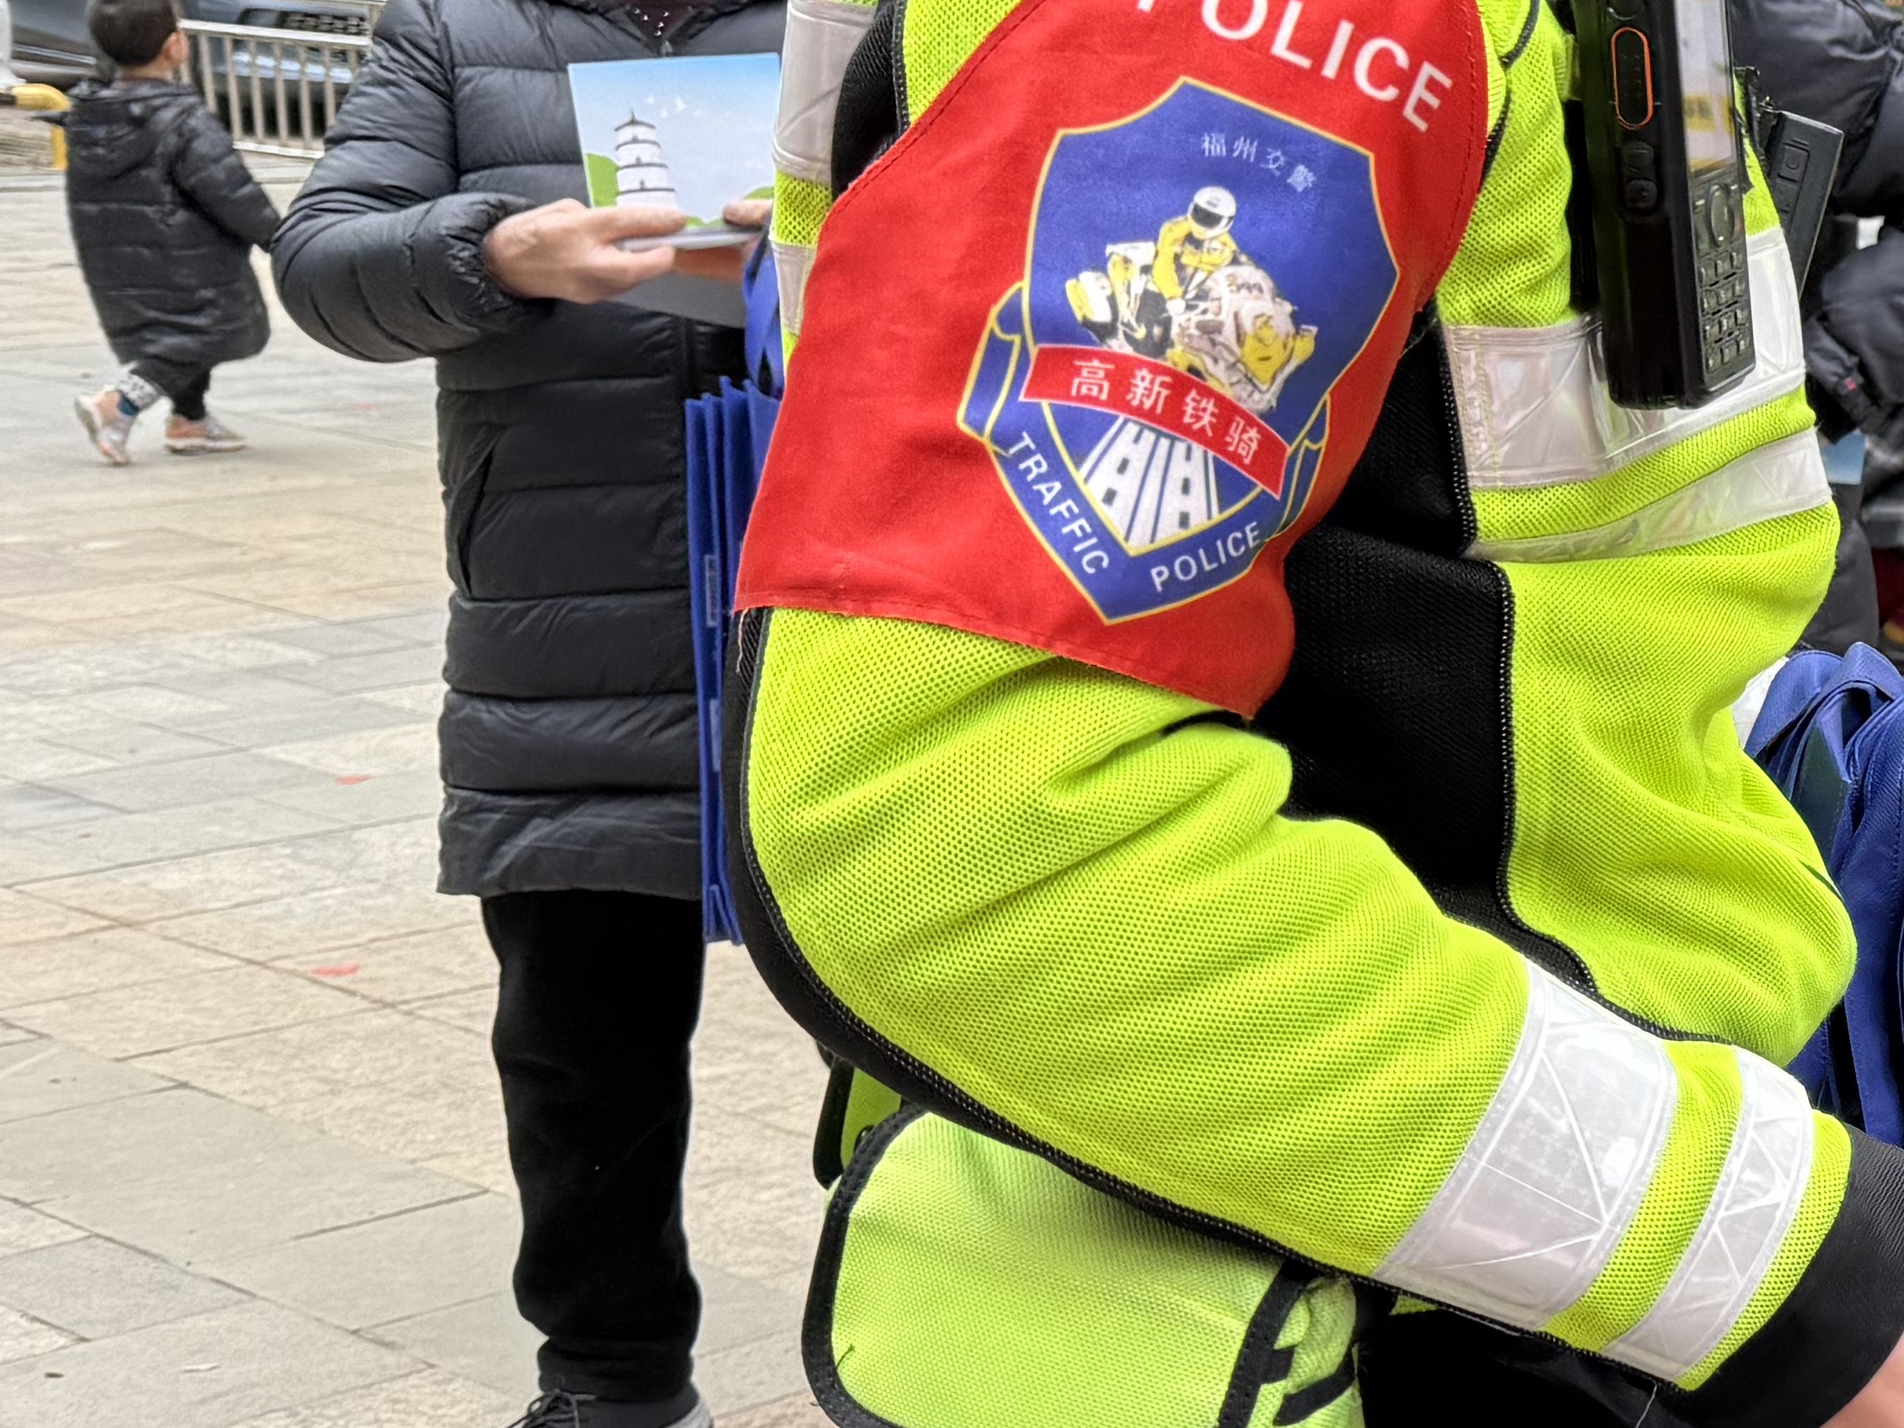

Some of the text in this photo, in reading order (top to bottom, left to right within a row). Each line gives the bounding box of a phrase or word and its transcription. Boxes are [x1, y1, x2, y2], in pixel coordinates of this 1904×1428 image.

[1070, 359, 1263, 466] 高新铁骑
[1007, 431, 1110, 576] TRAFFIC
[1150, 520, 1263, 591] POLICE
